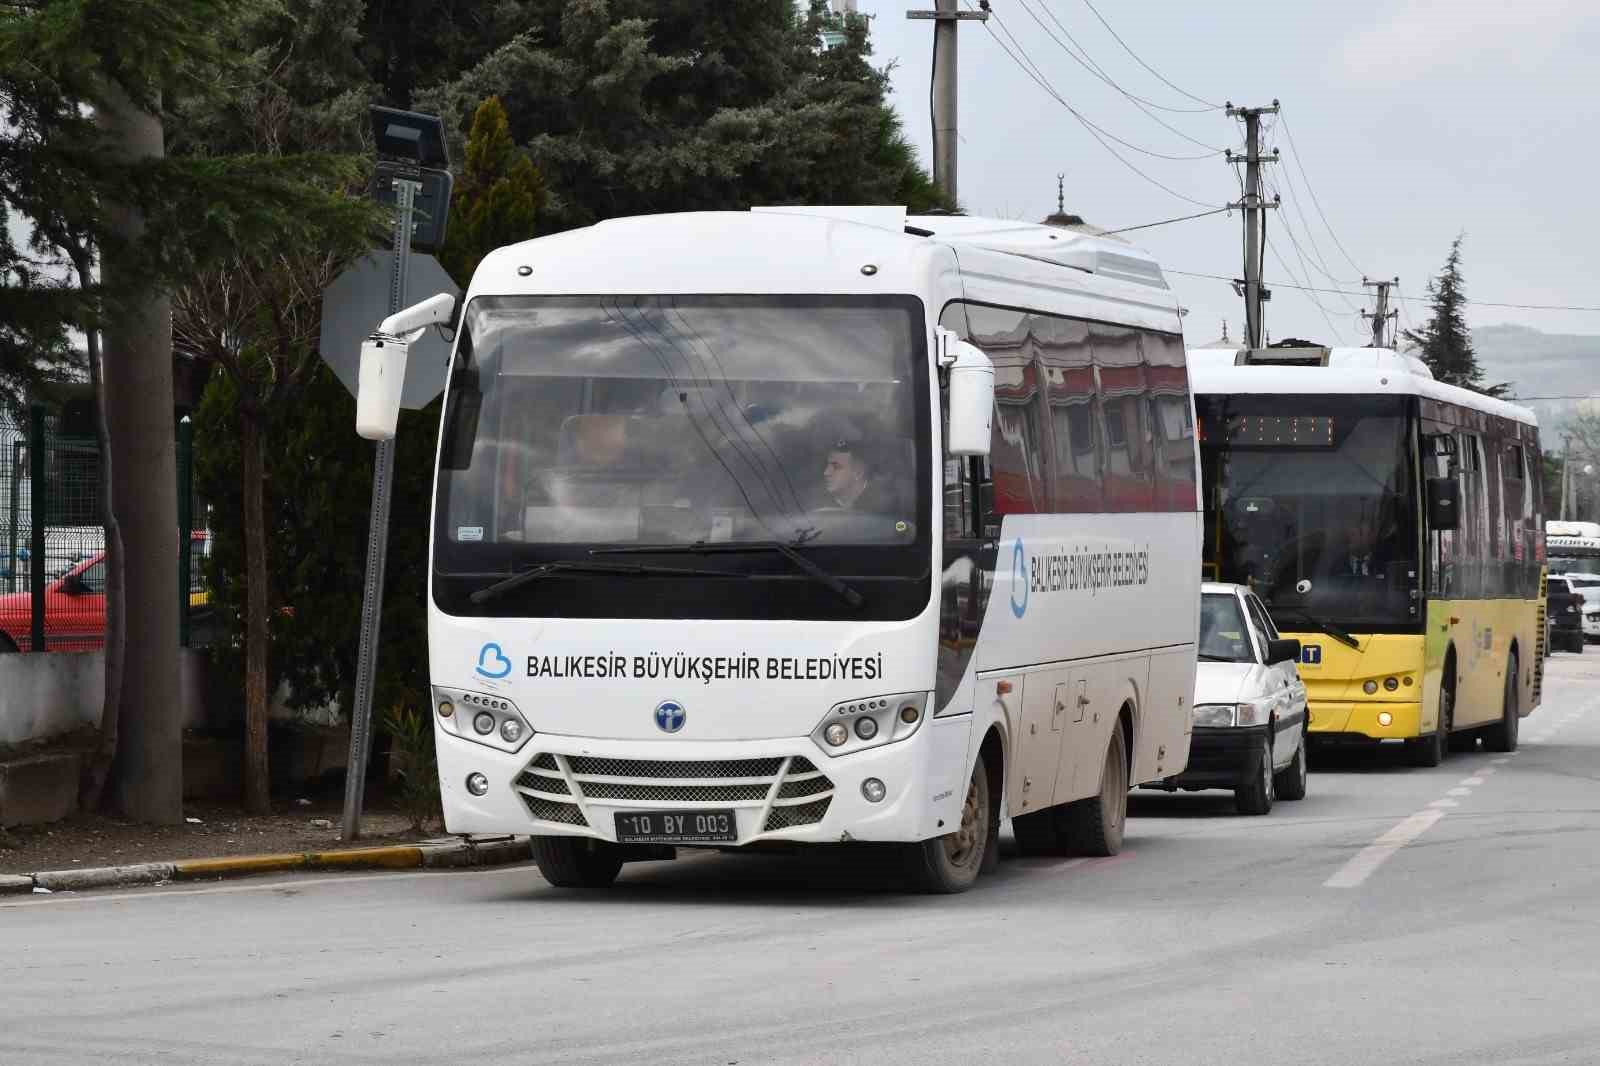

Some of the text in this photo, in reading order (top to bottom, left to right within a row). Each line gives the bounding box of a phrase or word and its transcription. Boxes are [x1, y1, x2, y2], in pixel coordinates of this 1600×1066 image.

[1031, 545, 1068, 592] BALIKESİR
[527, 651, 883, 685] BALIKESİR BÜYÜKŞEHİR BELEDİYESİ
[664, 815, 684, 834] BY
[696, 815, 729, 833] 003
